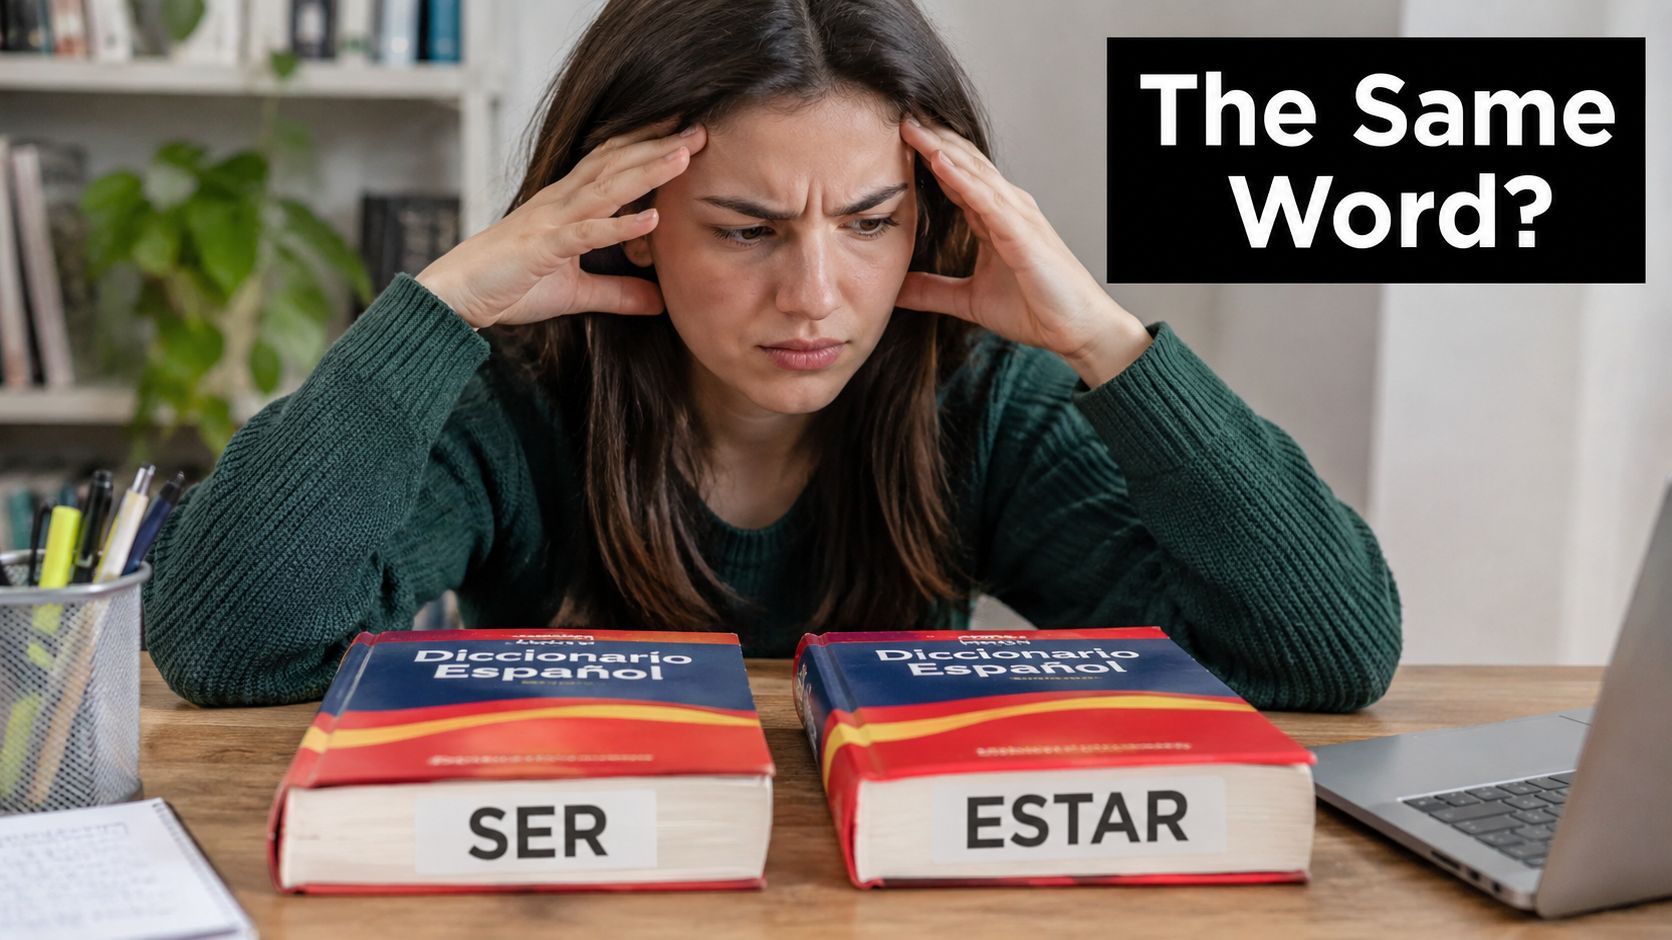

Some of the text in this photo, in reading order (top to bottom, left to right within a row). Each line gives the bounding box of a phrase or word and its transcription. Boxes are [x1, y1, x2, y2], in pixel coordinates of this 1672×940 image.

[874, 647, 1140, 661] Diccionario
[433, 663, 664, 681] Español
[906, 660, 1128, 678] Español
[965, 789, 1189, 850] ESTAR
[468, 804, 608, 861] SER
